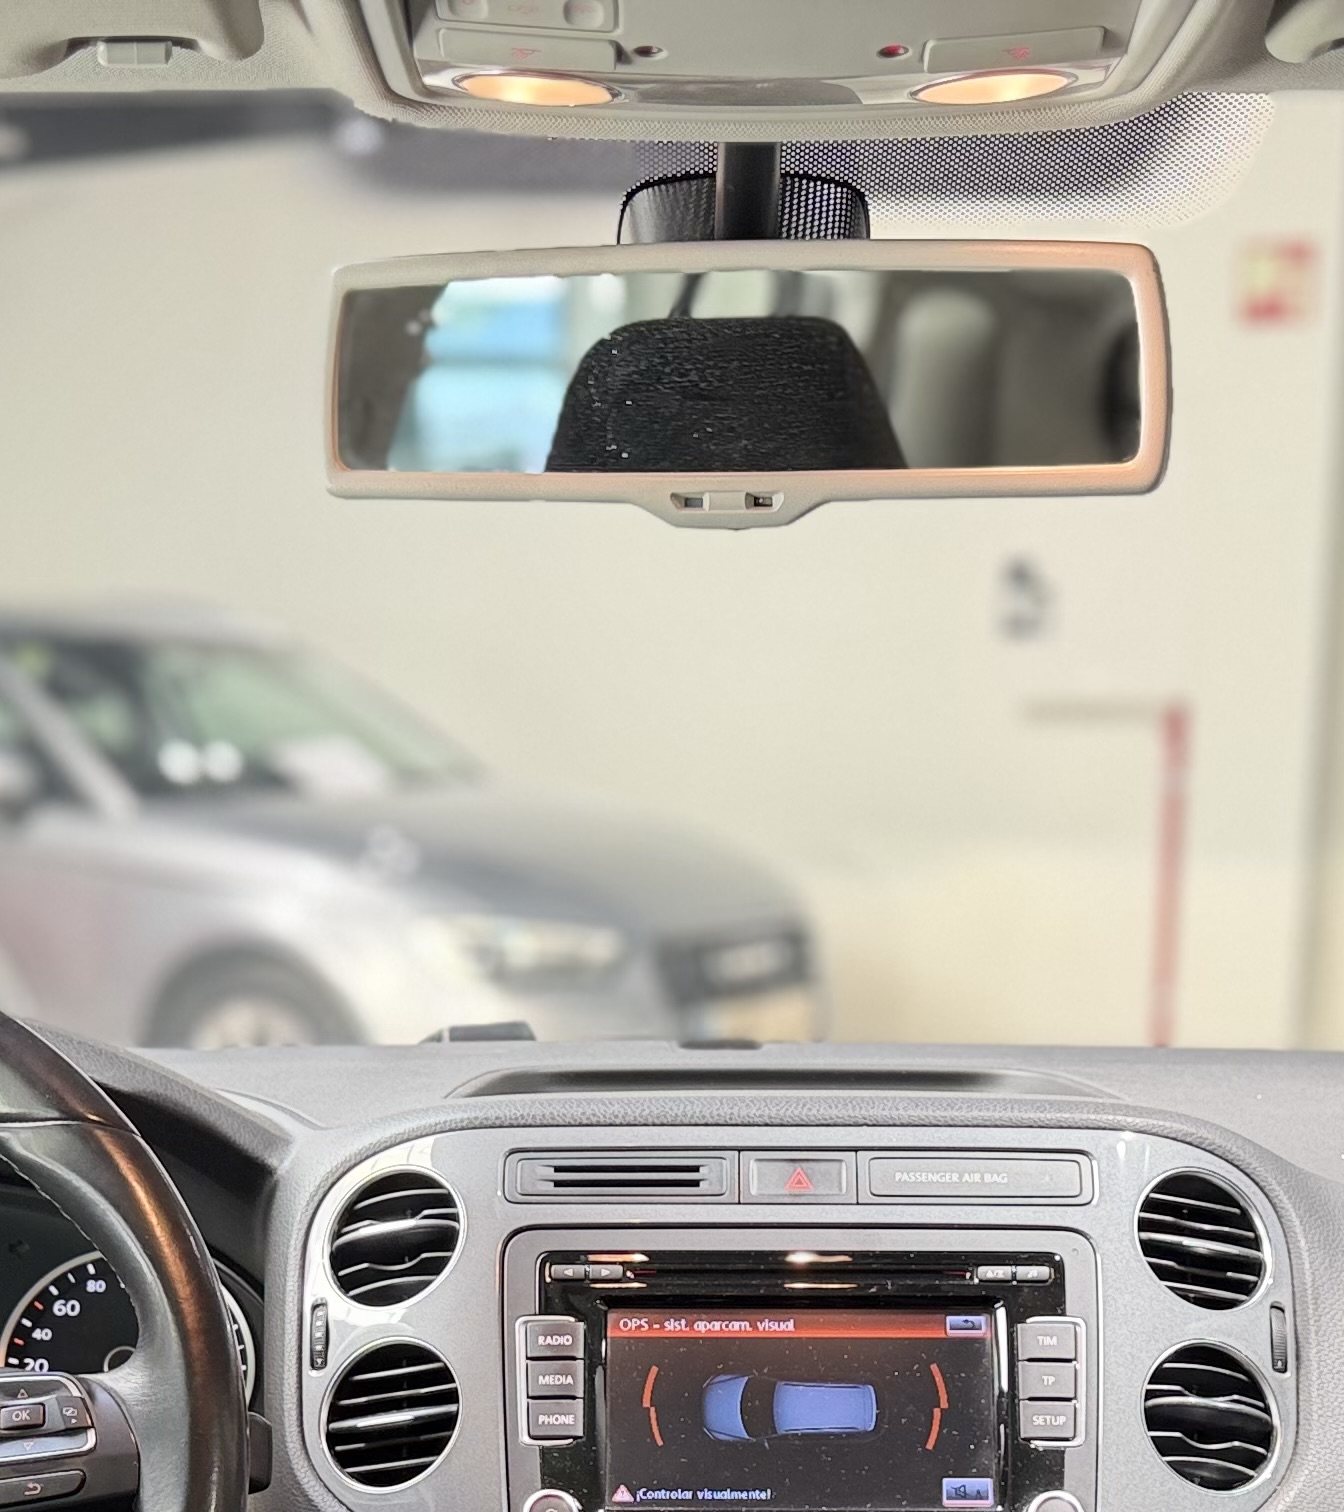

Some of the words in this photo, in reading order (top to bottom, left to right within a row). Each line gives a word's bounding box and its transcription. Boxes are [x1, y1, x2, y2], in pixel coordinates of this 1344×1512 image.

[895, 1172, 959, 1183] PASSENGER
[961, 1172, 982, 1183] AIR
[984, 1172, 1008, 1183] BAG
[85, 1279, 107, 1293] 80
[52, 1299, 81, 1317] 60
[619, 1318, 649, 1332] OPS
[663, 1317, 690, 1332] sist.
[693, 1319, 753, 1333] aparcam.
[756, 1318, 795, 1332] visual
[31, 1327, 53, 1341] 40
[537, 1335, 573, 1346] RADIO
[1037, 1335, 1058, 1346] TIM
[22, 1357, 50, 1373] 20
[538, 1375, 574, 1386] MEDIA
[1041, 1375, 1056, 1386] TP
[11, 1409, 31, 1422] OK
[538, 1414, 575, 1425] PHONE
[1032, 1415, 1067, 1426] SETUP
[635, 1488, 693, 1502] ¡Controlar
[696, 1487, 771, 1500] visualmente!
